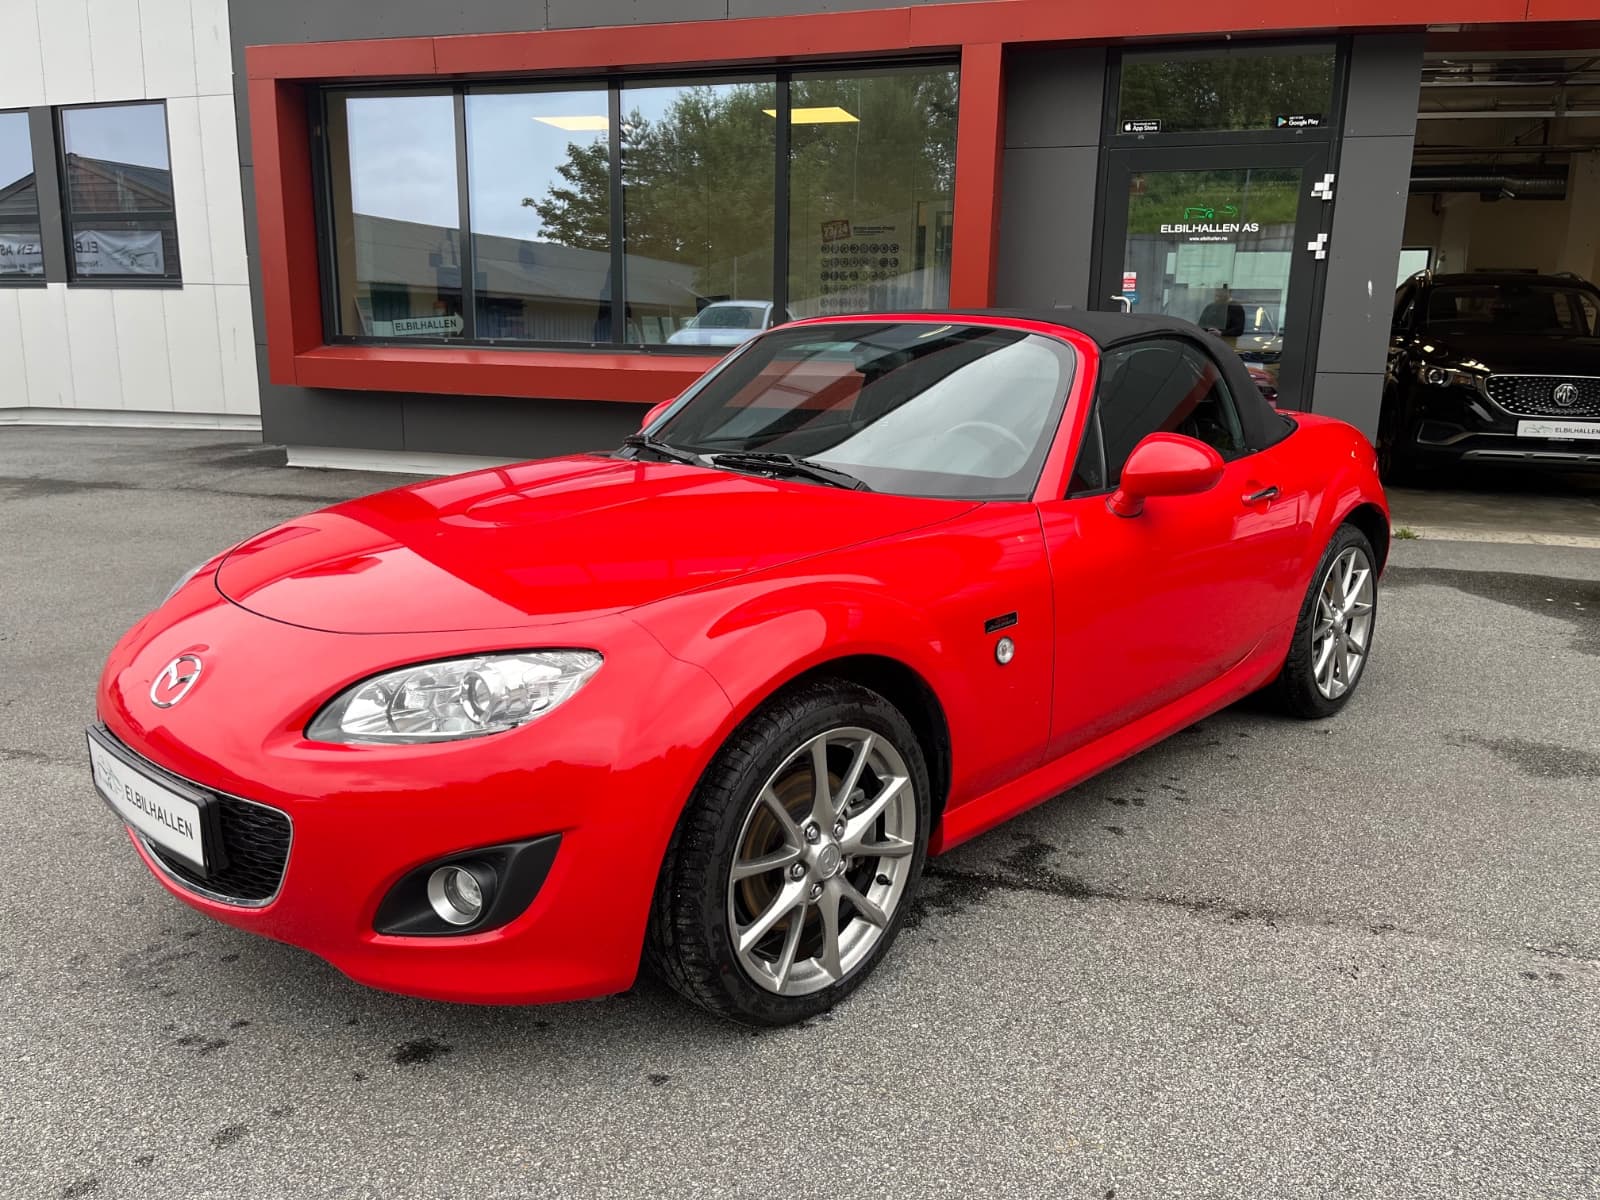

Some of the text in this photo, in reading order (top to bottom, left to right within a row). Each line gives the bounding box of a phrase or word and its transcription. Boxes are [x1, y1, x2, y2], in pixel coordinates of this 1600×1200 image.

[1289, 119, 1307, 127] Google
[1308, 118, 1319, 126] Play
[1160, 223, 1259, 233] ELBILHALLEN AS
[395, 319, 457, 332] ELBILHALLEN
[124, 784, 194, 840] ELBILHALLEN
